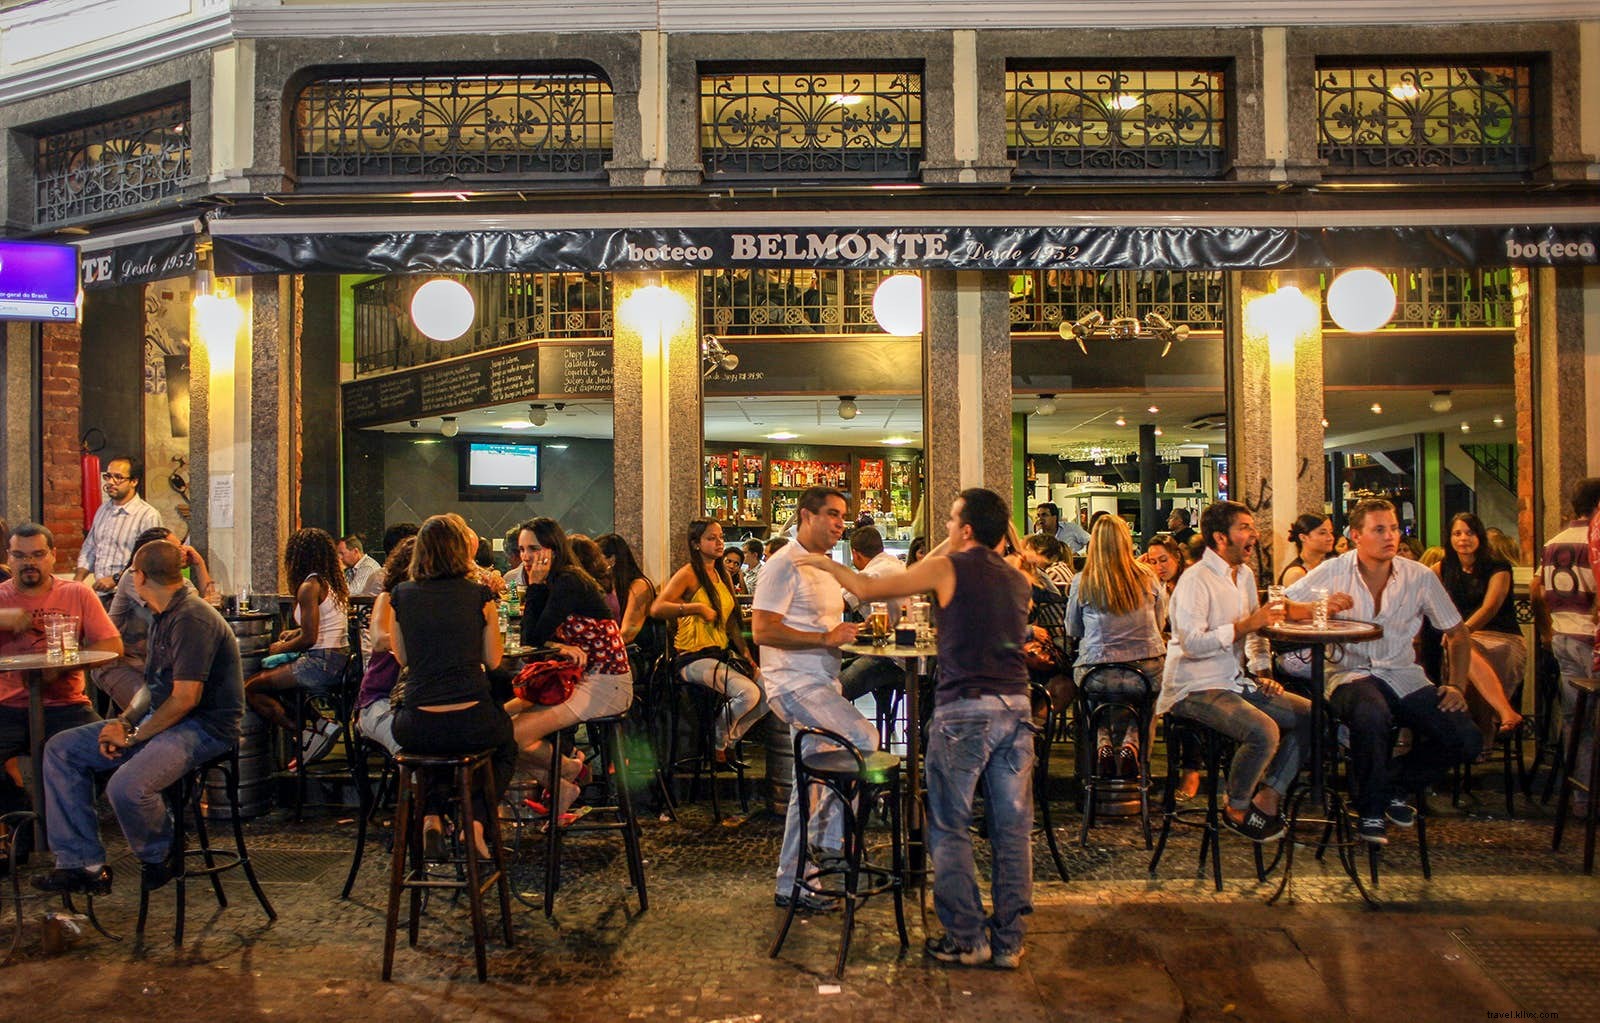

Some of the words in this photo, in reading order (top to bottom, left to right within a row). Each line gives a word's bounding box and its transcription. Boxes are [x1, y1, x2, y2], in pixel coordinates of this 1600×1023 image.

[628, 243, 714, 262] boteco
[731, 233, 949, 260] BELMONTE
[966, 240, 1022, 260] Desde
[1505, 239, 1596, 258] boteco
[121, 255, 157, 277] Desde
[161, 252, 193, 272] 1952
[51, 306, 68, 317] 64
[1552, 544, 1580, 599] 8
